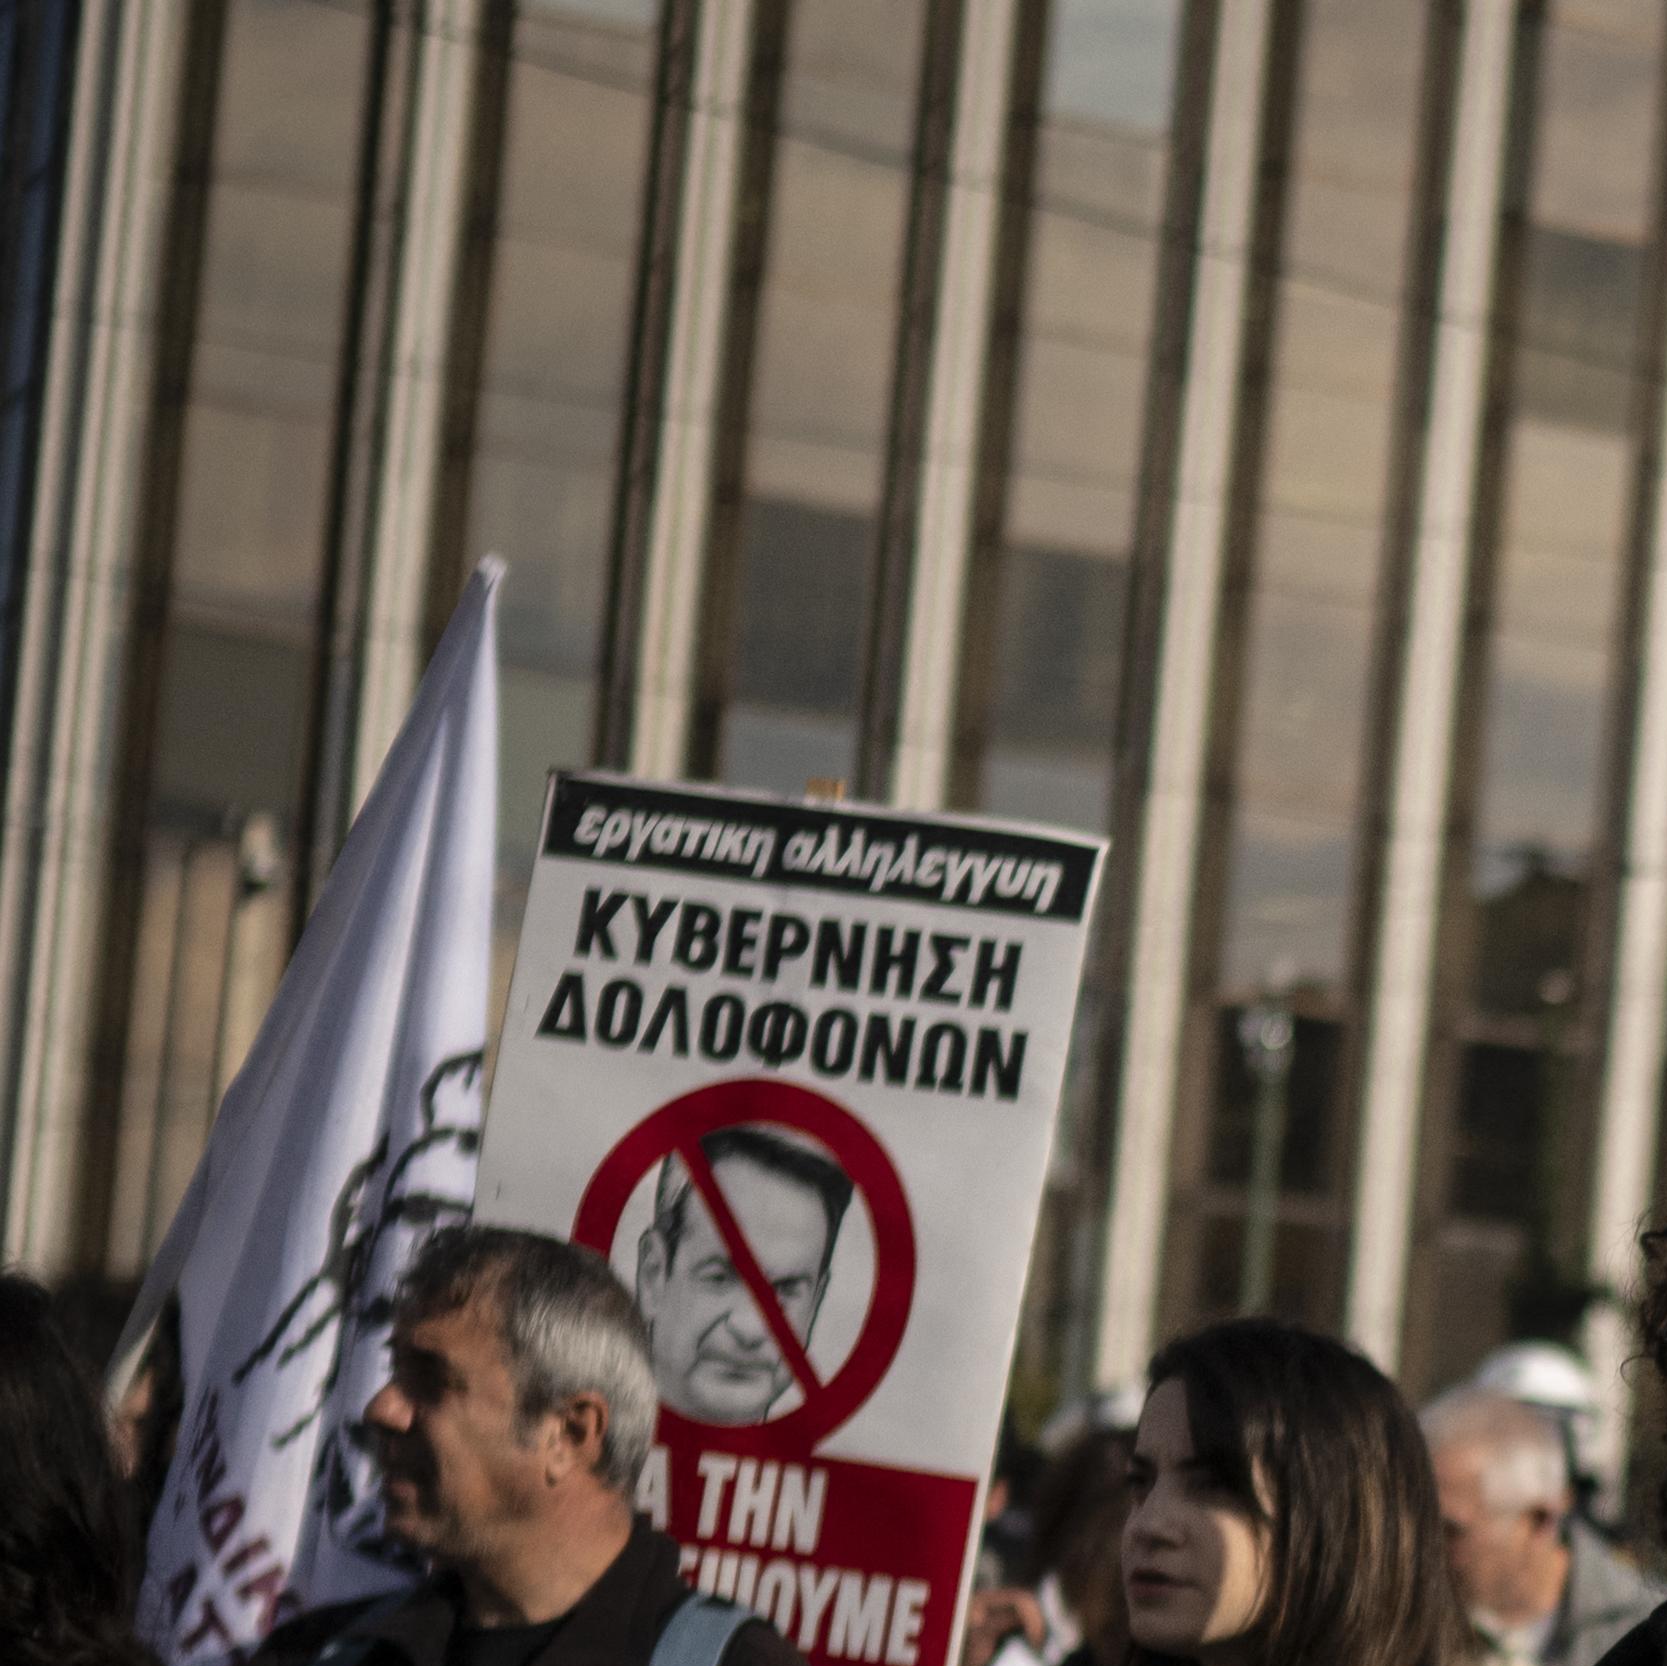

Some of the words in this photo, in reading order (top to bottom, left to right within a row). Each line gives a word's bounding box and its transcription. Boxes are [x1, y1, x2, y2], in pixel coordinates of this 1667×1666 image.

[573, 887, 1024, 1012] ΚΥΒΕΡΝΗΣΗ
[534, 972, 1028, 1102] ΔΟΛΟΦΟΝΩΝ
[695, 1450, 831, 1557] ΤΗΝ
